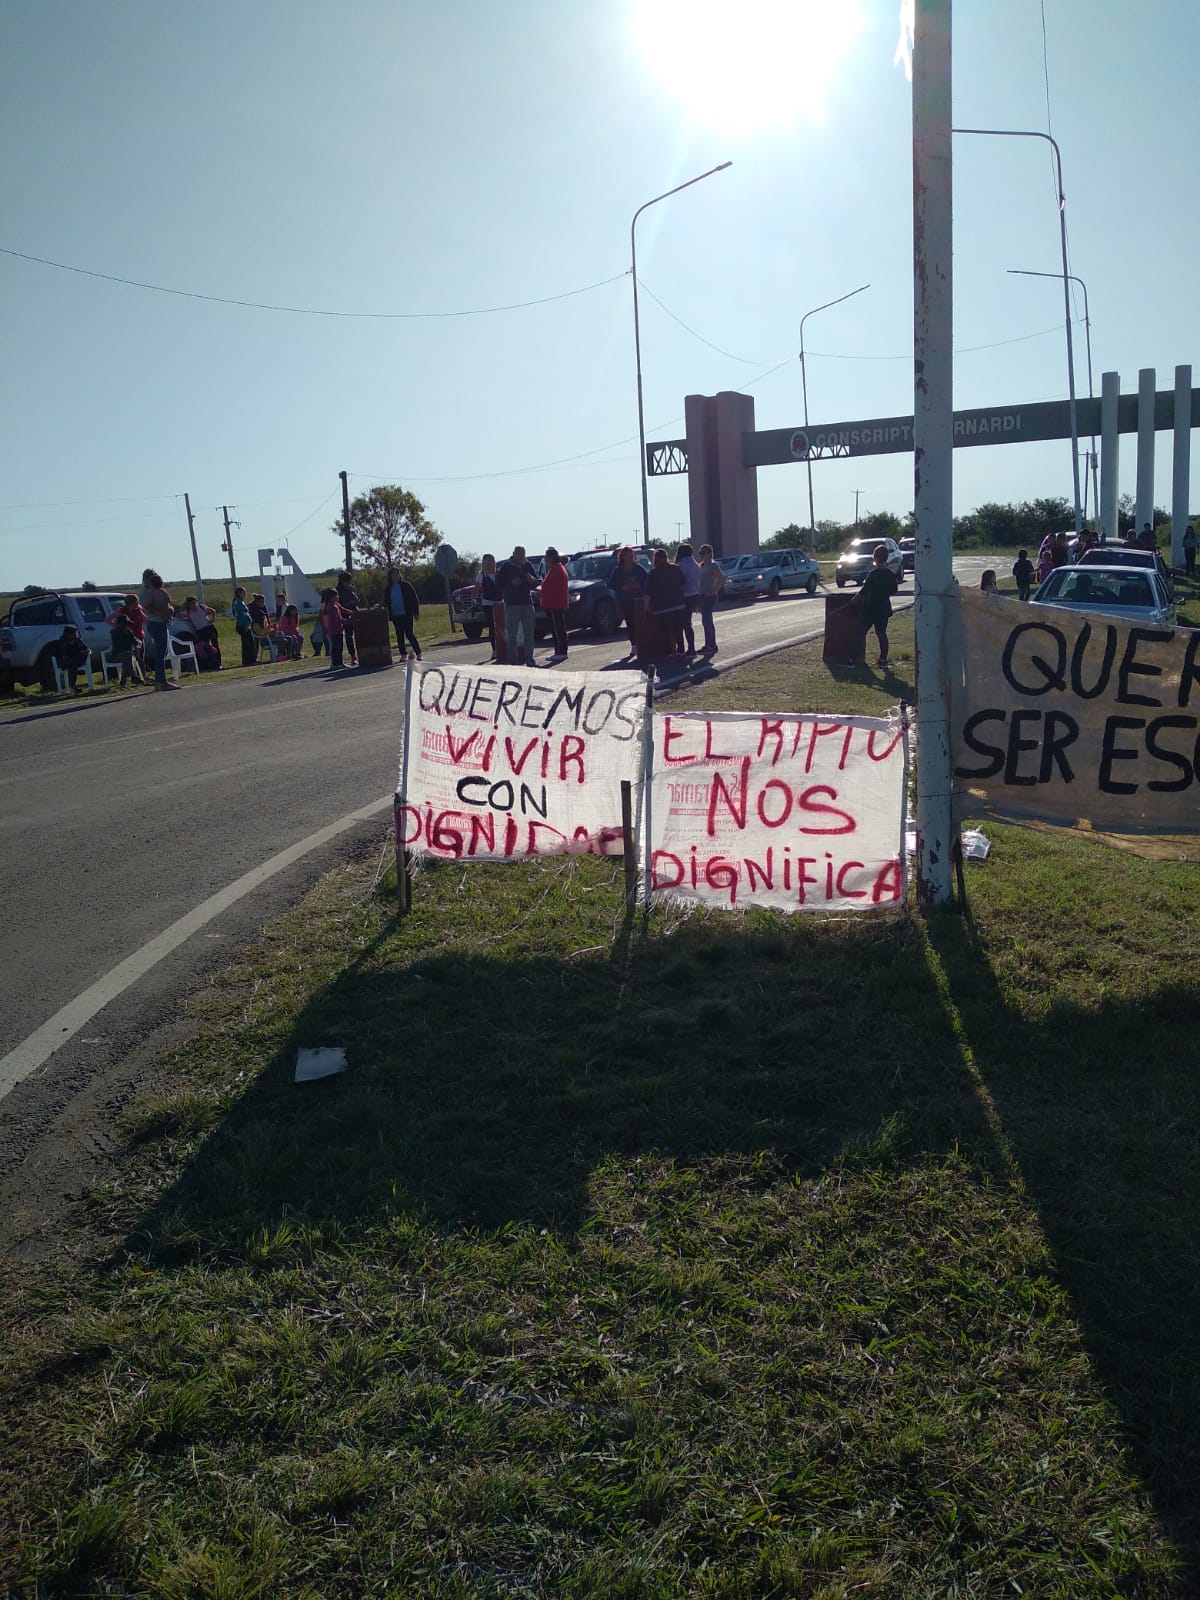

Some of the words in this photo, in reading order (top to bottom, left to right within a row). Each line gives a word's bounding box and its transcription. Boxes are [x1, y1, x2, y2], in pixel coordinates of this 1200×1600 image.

[953, 415, 1021, 436] RNARDI
[419, 668, 647, 741] QUEREMOS
[664, 717, 731, 761] EL
[954, 708, 1079, 786] SER
[1099, 715, 1200, 795] ES
[456, 775, 548, 819] CON
[708, 755, 857, 837] NOS
